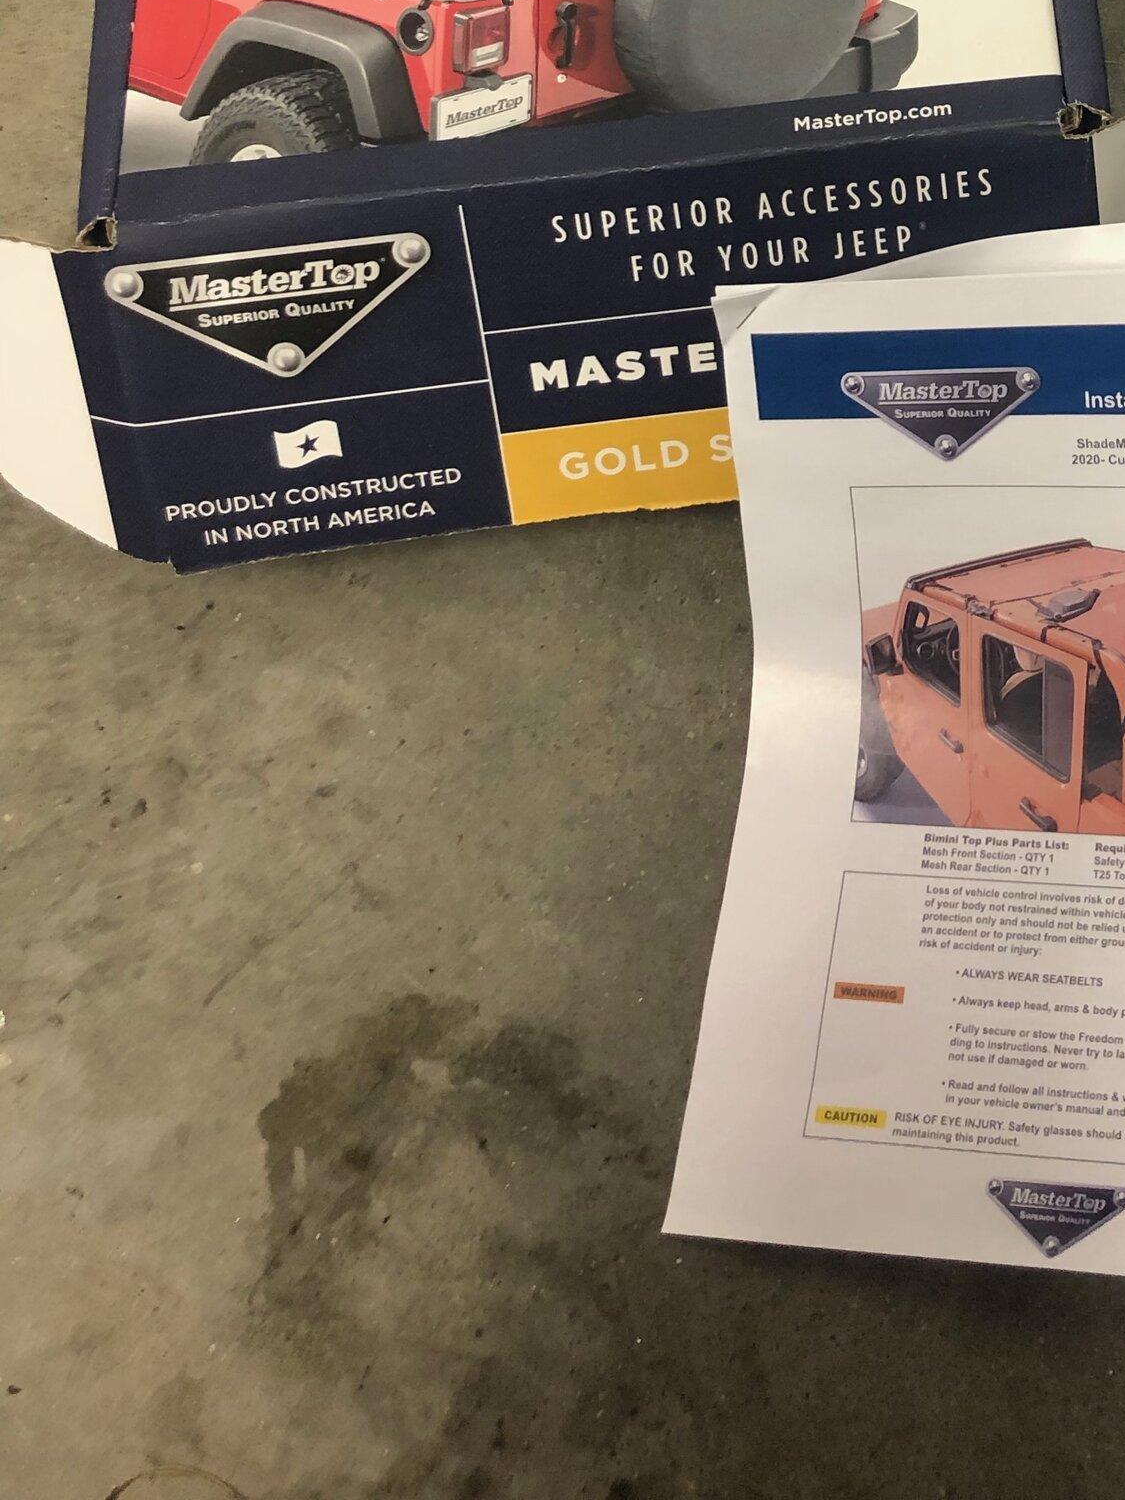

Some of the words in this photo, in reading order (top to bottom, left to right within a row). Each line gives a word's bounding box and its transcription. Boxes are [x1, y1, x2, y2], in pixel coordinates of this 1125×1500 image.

[445, 96, 524, 126] MasterTop
[793, 102, 953, 133] MasterTop.com
[551, 197, 733, 243] SUPERIOR
[758, 168, 994, 220] ACCESSORIES
[631, 245, 695, 282] FOR
[717, 236, 810, 273] YOUR
[168, 256, 380, 307] MasterTop
[198, 308, 280, 328] SUPERIOR
[285, 298, 356, 318] QUALITY
[529, 341, 718, 392] MASTE
[878, 380, 1008, 405] MasterTop
[894, 408, 944, 420] SUPERIOR
[947, 407, 992, 419] QUALITY
[558, 439, 690, 480] GOLD
[164, 490, 278, 522] PROUDLY
[284, 467, 463, 506] CONSTRUCTED
[203, 528, 231, 547] IN
[235, 516, 320, 543] NORTH
[327, 499, 436, 530] AMERICA
[923, 833, 959, 843] Bimini
[962, 835, 983, 847] Top
[984, 836, 1009, 846] Plus
[1011, 838, 1042, 848] Parts
[1044, 840, 1070, 850] List:
[922, 847, 949, 856] Mesh
[950, 848, 978, 858] Front
[978, 850, 1017, 860] Section
[1024, 852, 1046, 861] QTY
[1048, 853, 1054, 862] 1
[1093, 856, 1125, 869] Safety
[920, 860, 948, 870] Mesh
[948, 861, 972, 871] Rear
[974, 862, 1012, 873] Section
[1019, 865, 1042, 874] QTY
[1044, 866, 1050, 875] 1
[1093, 869, 1111, 878] T25
[925, 885, 950, 895] Loss
[952, 887, 963, 896] of
[964, 887, 1000, 898] vehicle
[1002, 889, 1038, 900] control
[1039, 891, 1081, 902] involves
[1083, 894, 1103, 904] risk
[1104, 896, 1116, 905] of
[924, 899, 935, 908] of
[936, 901, 959, 911] your
[960, 901, 987, 913] body
[988, 902, 1006, 912] not
[1006, 903, 1058, 915] restrained
[1059, 906, 1091, 917] within
[961, 968, 1005, 979] ALWAYS
[1006, 971, 1040, 981] WEAR
[1041, 973, 1103, 985] SEATBELTS
[840, 986, 898, 1001] WARNING
[958, 996, 995, 1010] Always
[996, 999, 1022, 1011] keep
[1022, 1001, 1052, 1012] head,
[1053, 1004, 1080, 1013] arms
[1081, 1005, 1090, 1014] &
[1092, 1006, 1119, 1018] body
[957, 1096, 981, 1108] your
[983, 1097, 1020, 1108] vehicle
[1064, 1104, 1105, 1115] manual
[824, 1110, 879, 1125] CAUTION
[894, 1113, 920, 1123] RISK
[922, 1115, 937, 1124] OF
[939, 1116, 962, 1126] EYE
[1007, 1122, 1041, 1135] Safety
[1042, 1124, 1083, 1138] glasses
[1085, 1128, 1122, 1140] should
[891, 1127, 953, 1143] maintaining
[954, 1132, 974, 1142] this
[976, 1134, 1020, 1148] product.
[1010, 1187, 1106, 1214] MasterTop
